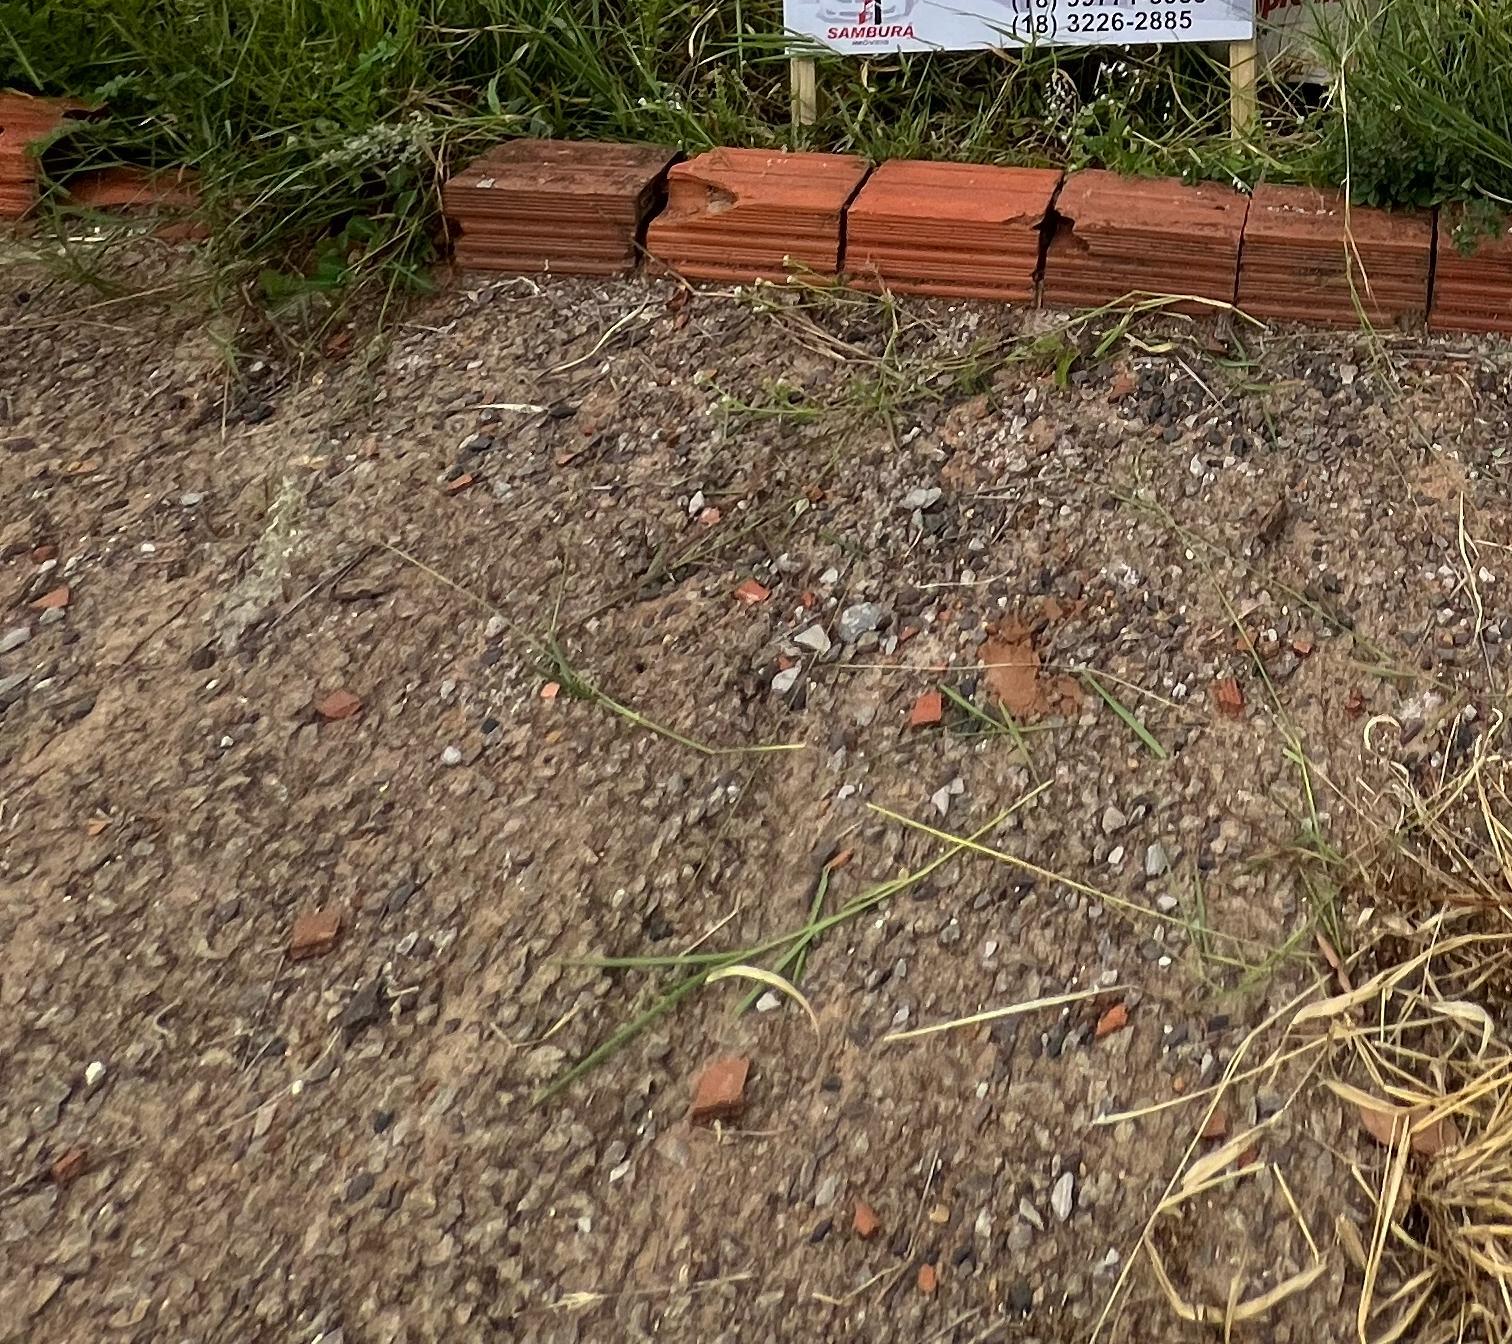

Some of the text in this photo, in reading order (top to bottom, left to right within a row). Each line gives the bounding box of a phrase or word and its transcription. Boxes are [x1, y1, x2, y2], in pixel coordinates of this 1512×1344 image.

[827, 22, 914, 39] SAMBURÁ
[1011, 10, 1193, 38] (18) 3226-2885
